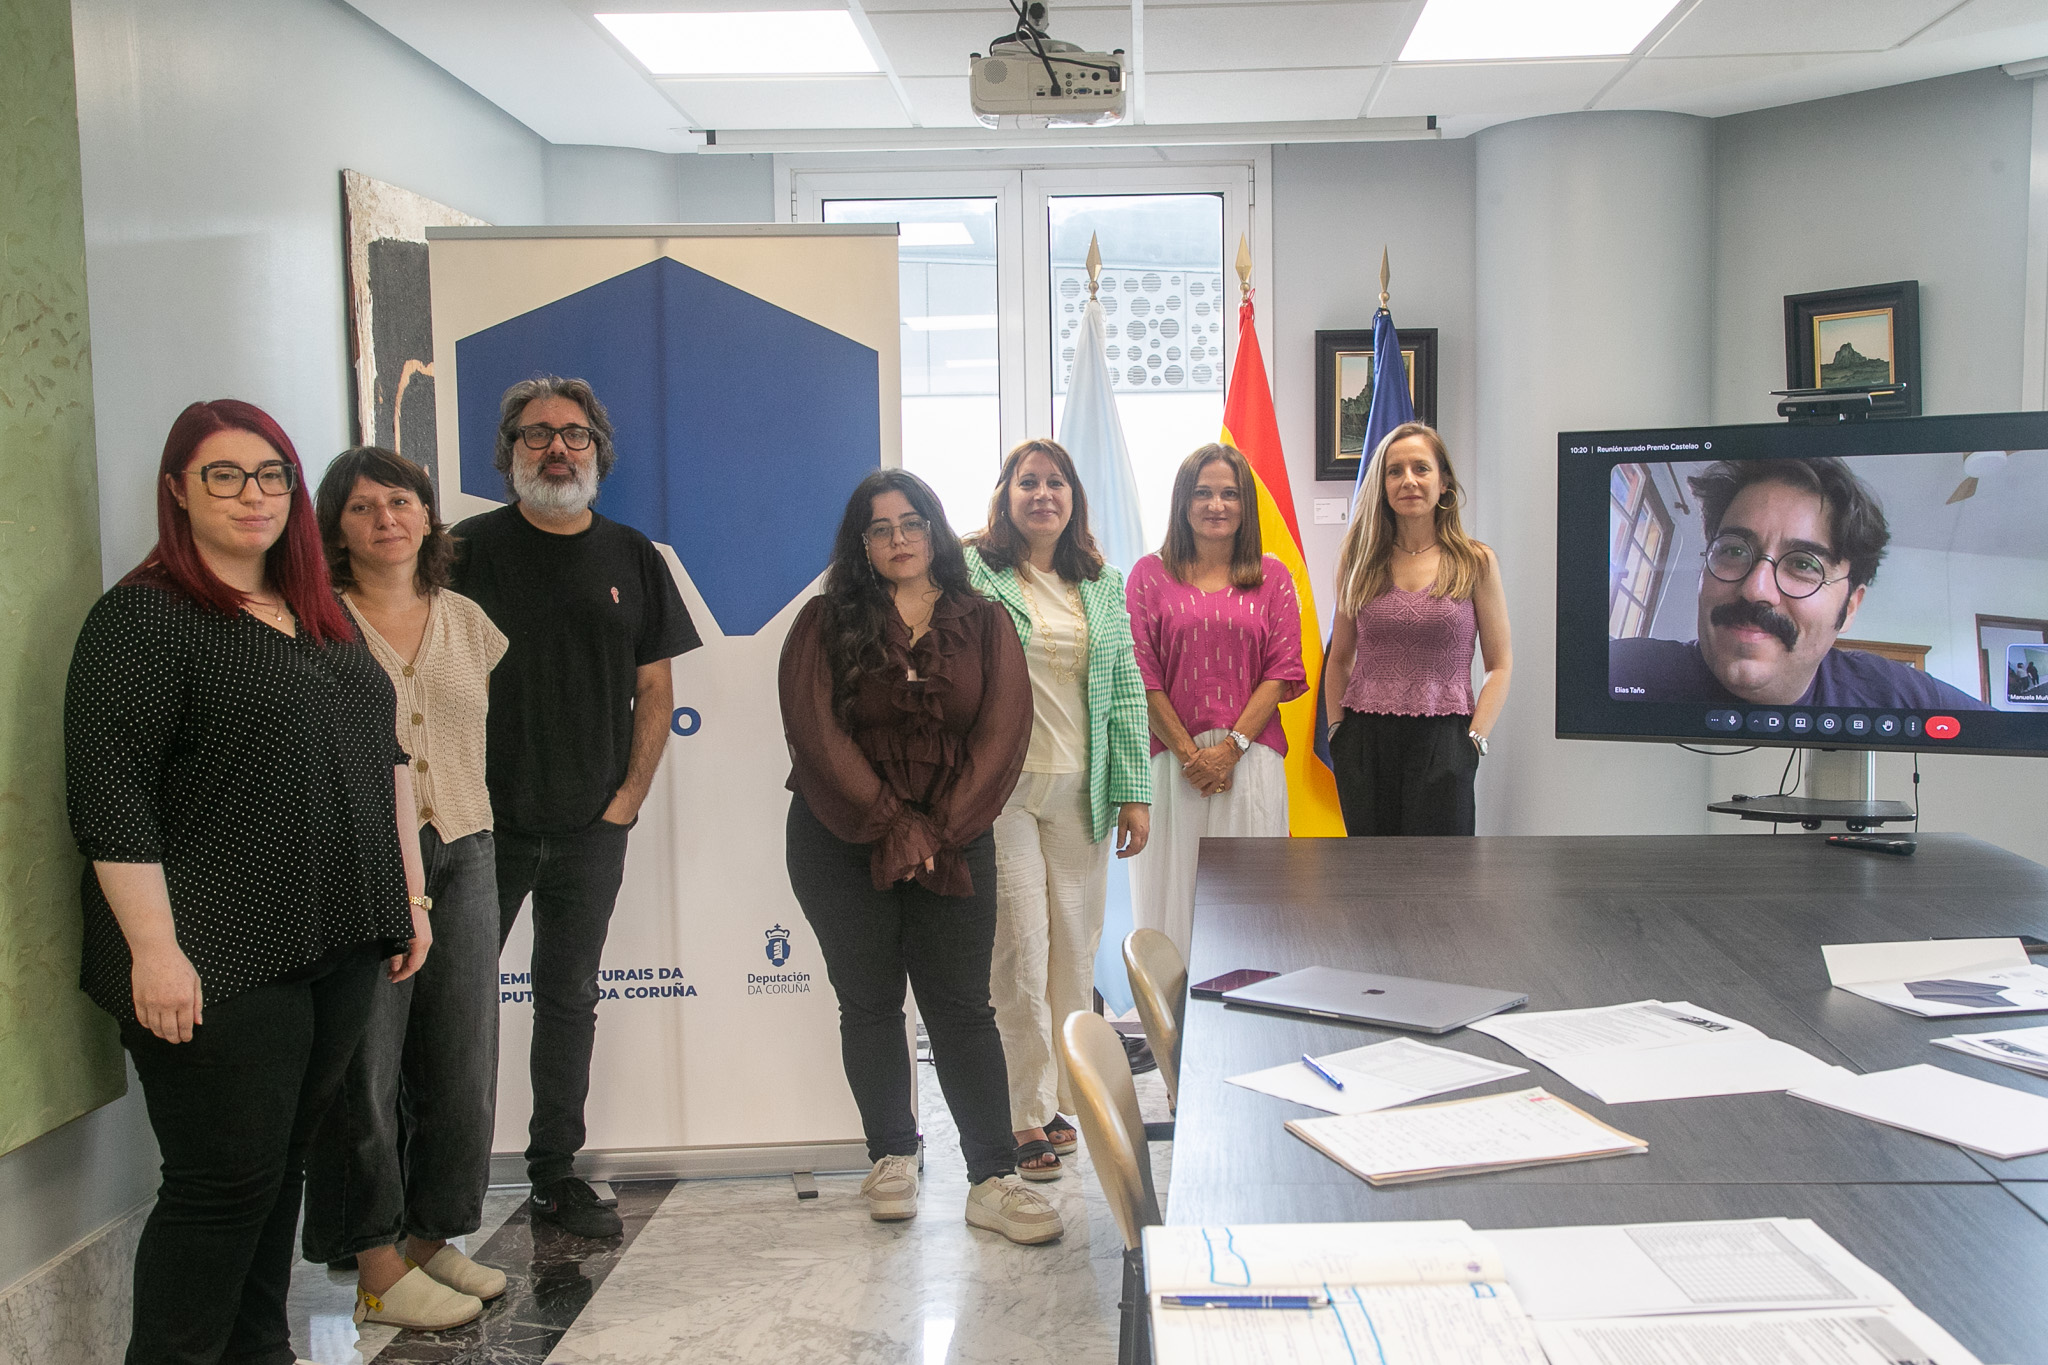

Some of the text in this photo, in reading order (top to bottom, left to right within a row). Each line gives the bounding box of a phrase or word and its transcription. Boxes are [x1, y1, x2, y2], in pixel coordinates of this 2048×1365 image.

[1570, 446, 1588, 454] 10:20
[1597, 445, 1623, 453] Reunión
[1646, 443, 1670, 451] Premio
[1670, 442, 1700, 450] Castelao
[658, 967, 684, 980] DA
[747, 972, 810, 985] Deputación
[599, 988, 620, 1000] DA
[624, 982, 698, 999] CORUÑA
[747, 982, 811, 995] DA CORUÑA
